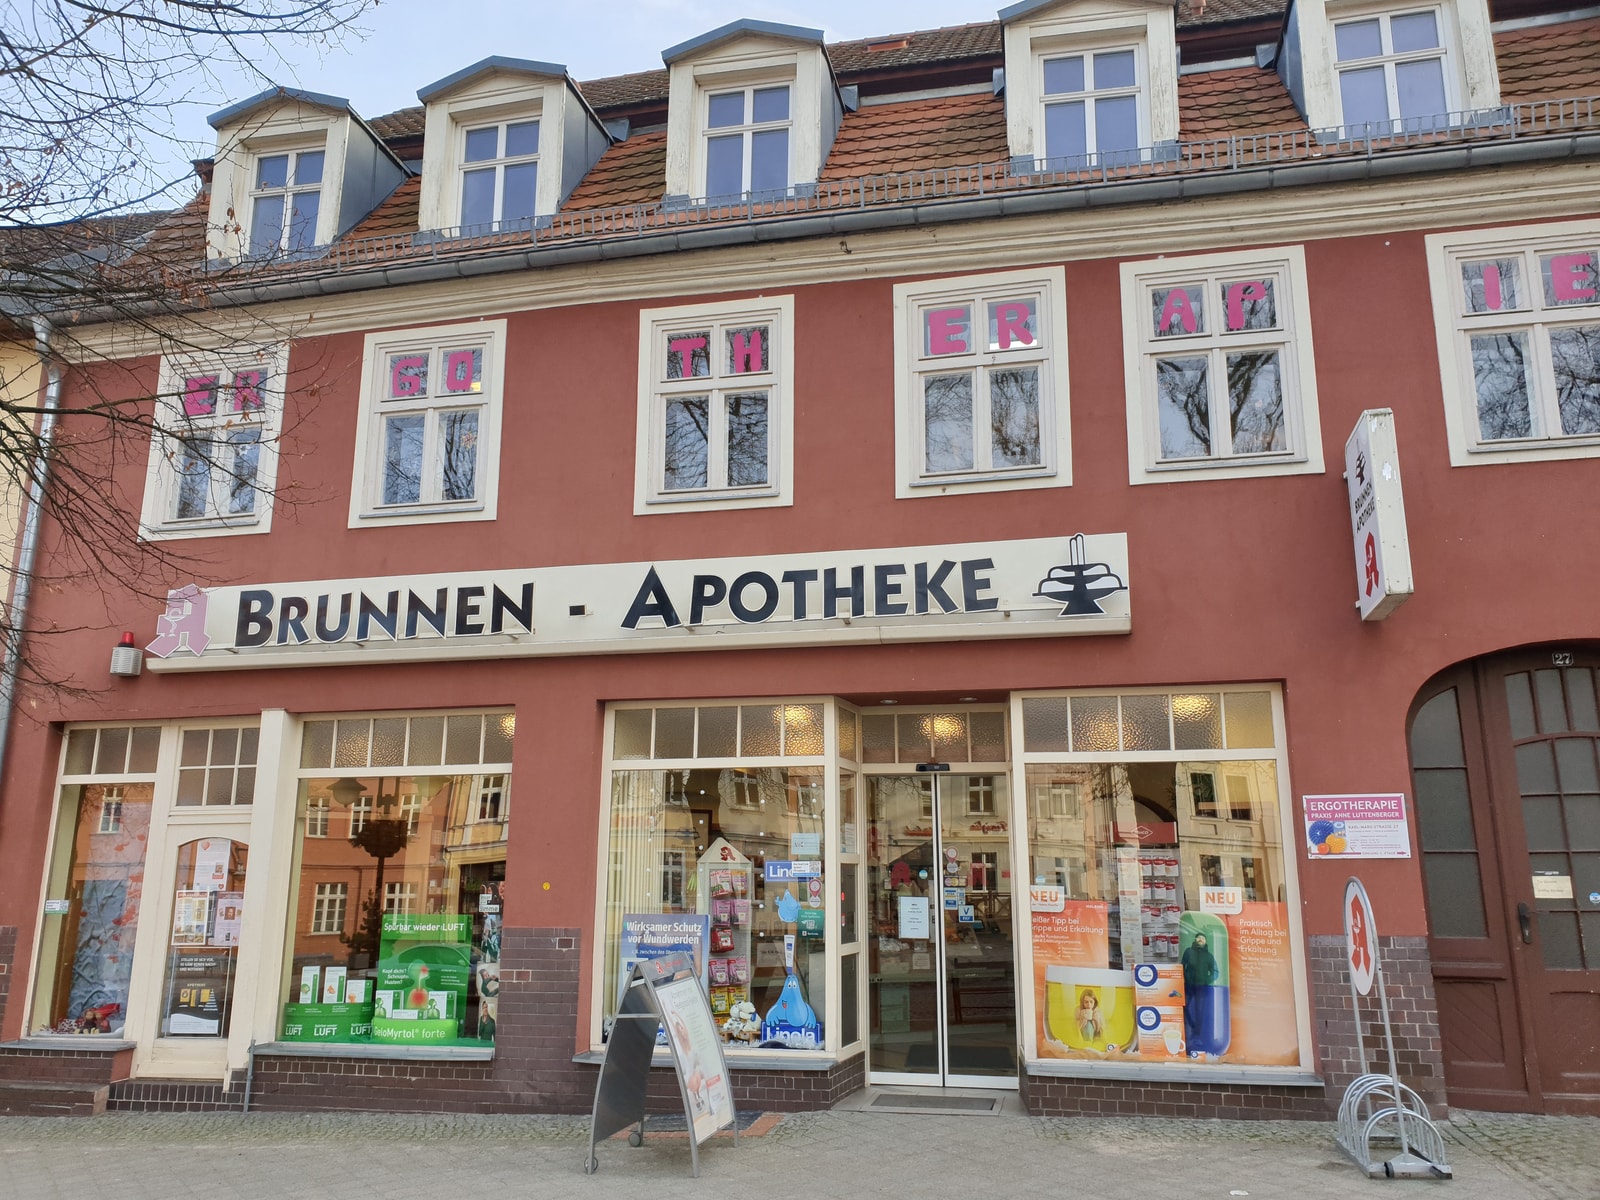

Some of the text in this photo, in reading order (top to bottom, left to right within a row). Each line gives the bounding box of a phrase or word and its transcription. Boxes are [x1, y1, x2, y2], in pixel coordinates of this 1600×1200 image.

[1354, 479, 1373, 514] BRUNNEN
[1356, 497, 1375, 533] APOTHEKE
[234, 581, 536, 648] BRUNNEN
[619, 557, 1000, 630] APOTHEKE
[1555, 653, 1571, 664] 27
[1310, 800, 1399, 811] ERGOTHERAPIE
[1030, 890, 1059, 903] NEU
[1205, 891, 1236, 904] NEU
[626, 920, 703, 932] Wirksamer Schutz
[1051, 916, 1067, 925] Tipp
[1068, 917, 1080, 925] bei
[1239, 918, 1273, 928] Praktisch
[384, 922, 465, 932] Spürbar wieder LUFT
[1032, 925, 1052, 933] rippe
[1069, 925, 1104, 935] Erkältung
[627, 933, 699, 944] vor Wundwerden
[1250, 928, 1273, 938] Alltag
[1274, 928, 1287, 937] bei
[1240, 936, 1266, 946] Grippe
[1240, 945, 1277, 956] Erkältung
[285, 1027, 303, 1036] LUFT
[313, 1027, 338, 1036] LUFT
[350, 1026, 372, 1035] LUFT
[422, 1028, 446, 1038] forte
[766, 1026, 815, 1041] Linola
